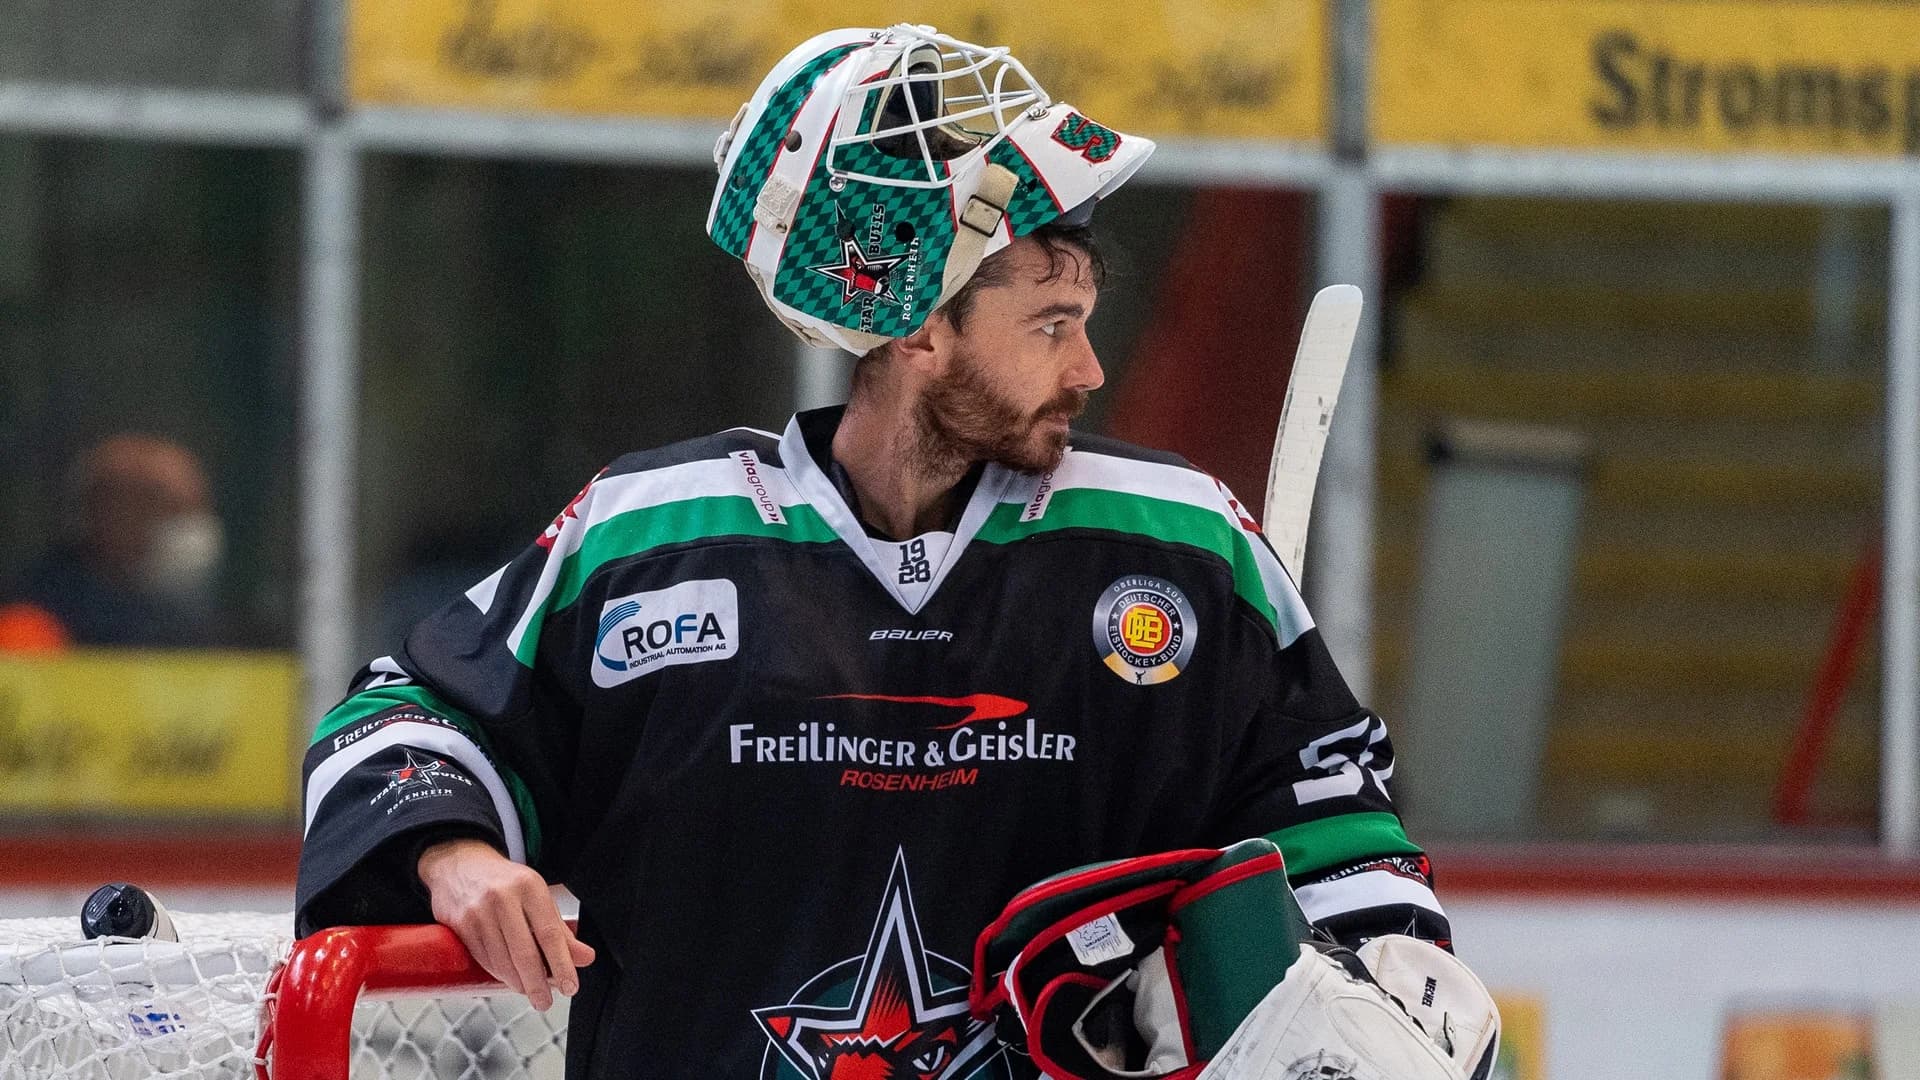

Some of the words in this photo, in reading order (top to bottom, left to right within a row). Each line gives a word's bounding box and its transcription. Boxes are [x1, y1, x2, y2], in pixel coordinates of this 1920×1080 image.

[868, 203, 885, 255] BULLS
[1028, 471, 1054, 520] vitagro
[899, 538, 926, 566] 19
[898, 559, 931, 585] 28
[1113, 578, 1162, 593] OBERLIGA
[1118, 593, 1177, 617] DEUTSCHER
[622, 612, 726, 660] ROFA
[868, 628, 954, 643] BAUER
[629, 652, 665, 670] INDUSTRIAL
[665, 645, 713, 657] AUTOMATION
[714, 642, 727, 651] AG
[923, 741, 946, 768] &
[839, 767, 979, 792] ROSENHEIM
[370, 781, 398, 806] STAR
[386, 788, 454, 816] ROSENHEIM
